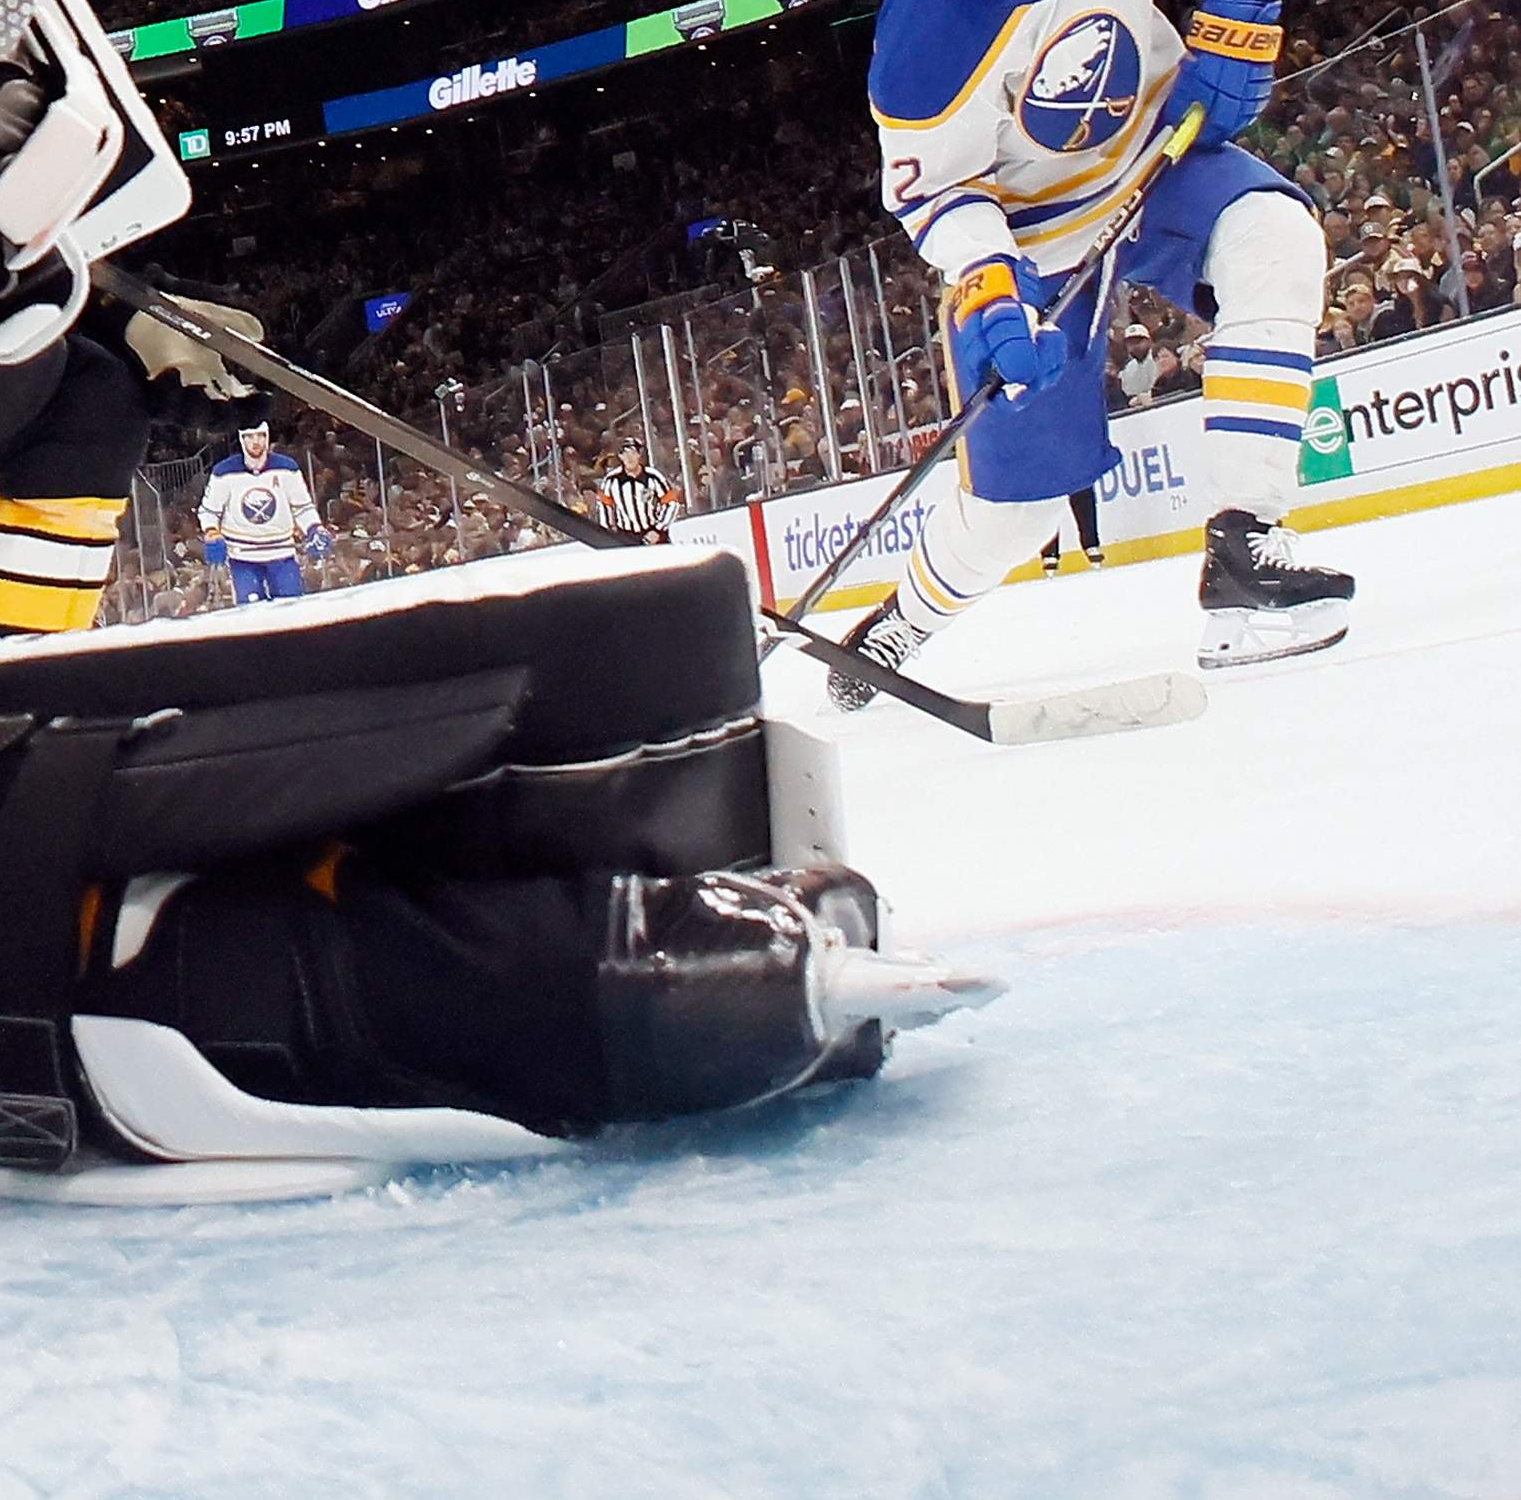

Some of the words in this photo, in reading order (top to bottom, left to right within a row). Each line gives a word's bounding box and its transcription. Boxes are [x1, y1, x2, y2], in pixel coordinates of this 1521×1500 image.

[429, 56, 537, 113] Gillette
[181, 131, 209, 157] TD
[224, 123, 260, 148] 9:57
[261, 118, 292, 142] PM
[785, 498, 951, 572] ticketmast
